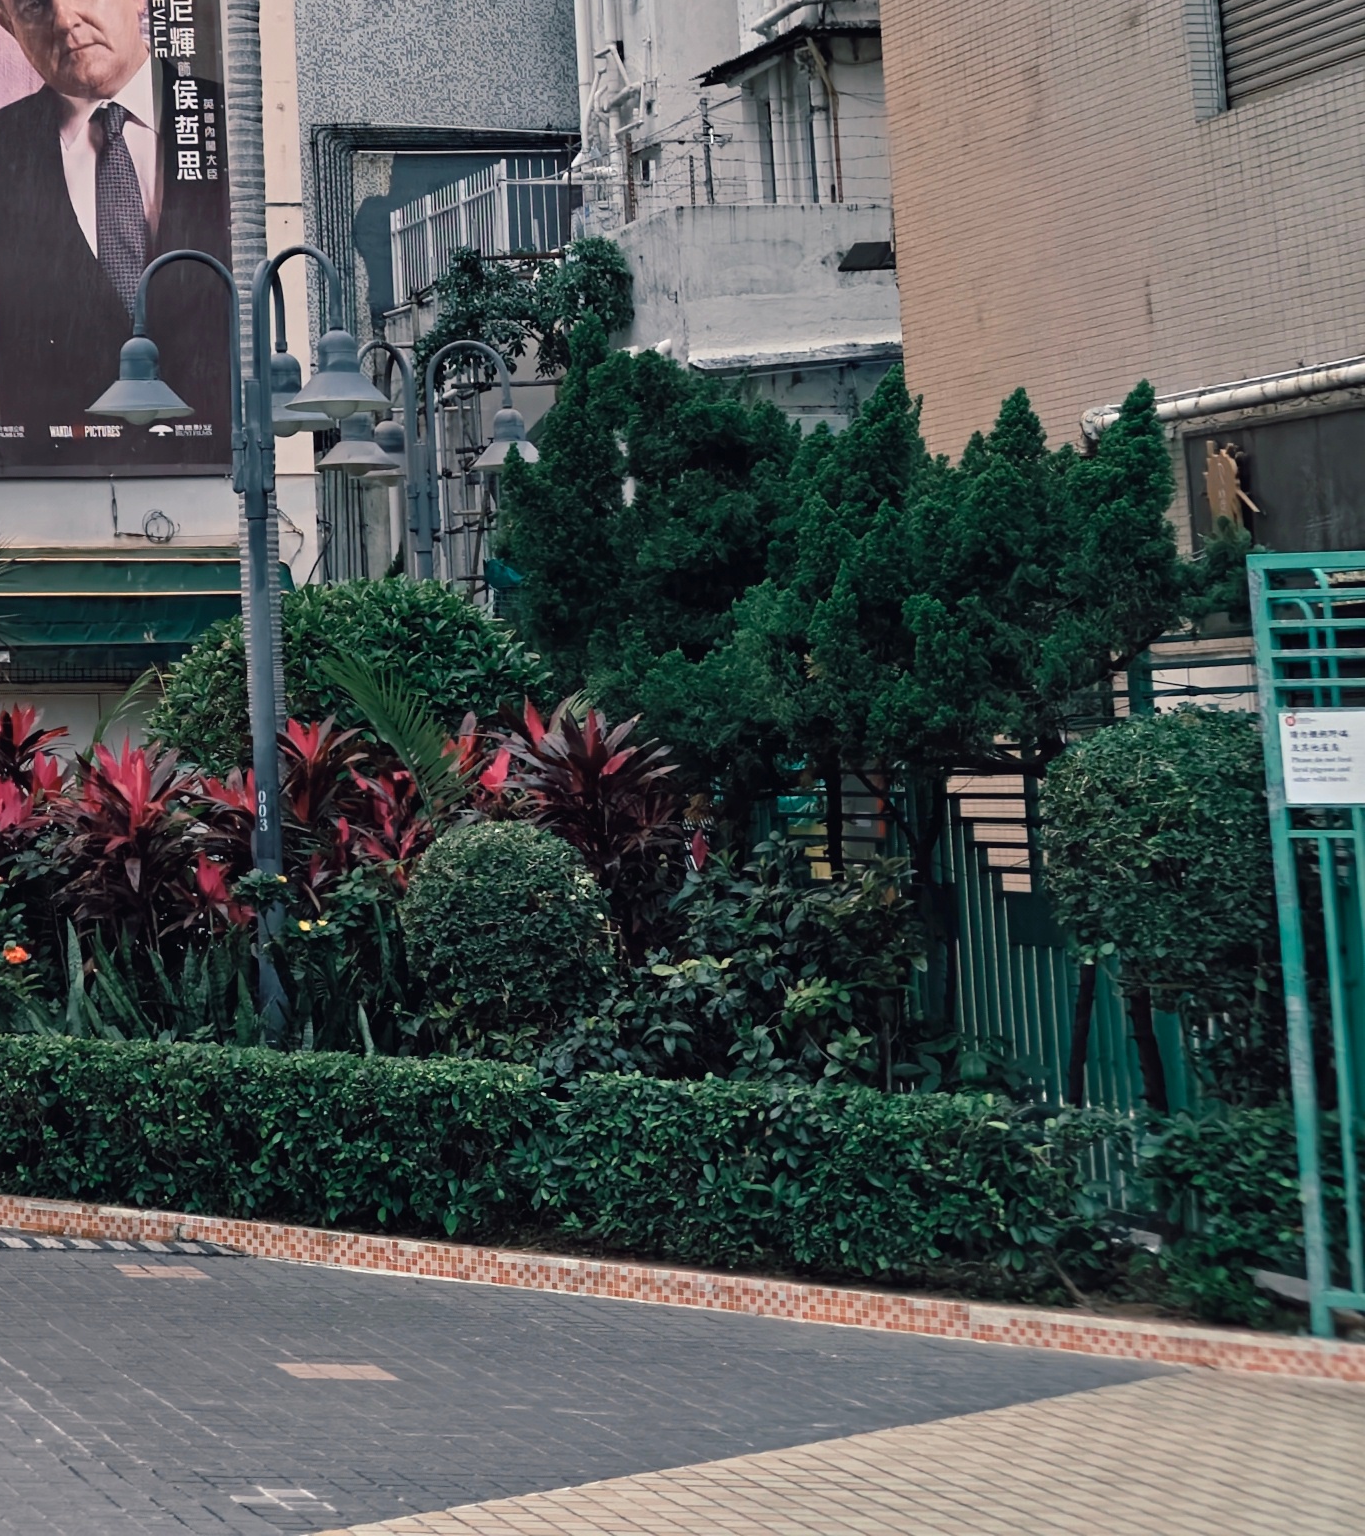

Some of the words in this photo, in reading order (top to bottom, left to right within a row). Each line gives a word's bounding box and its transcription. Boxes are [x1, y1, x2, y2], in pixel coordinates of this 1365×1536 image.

[49, 425, 73, 438] WANDA
[84, 425, 121, 438] PICTURES
[258, 790, 268, 832] 003
